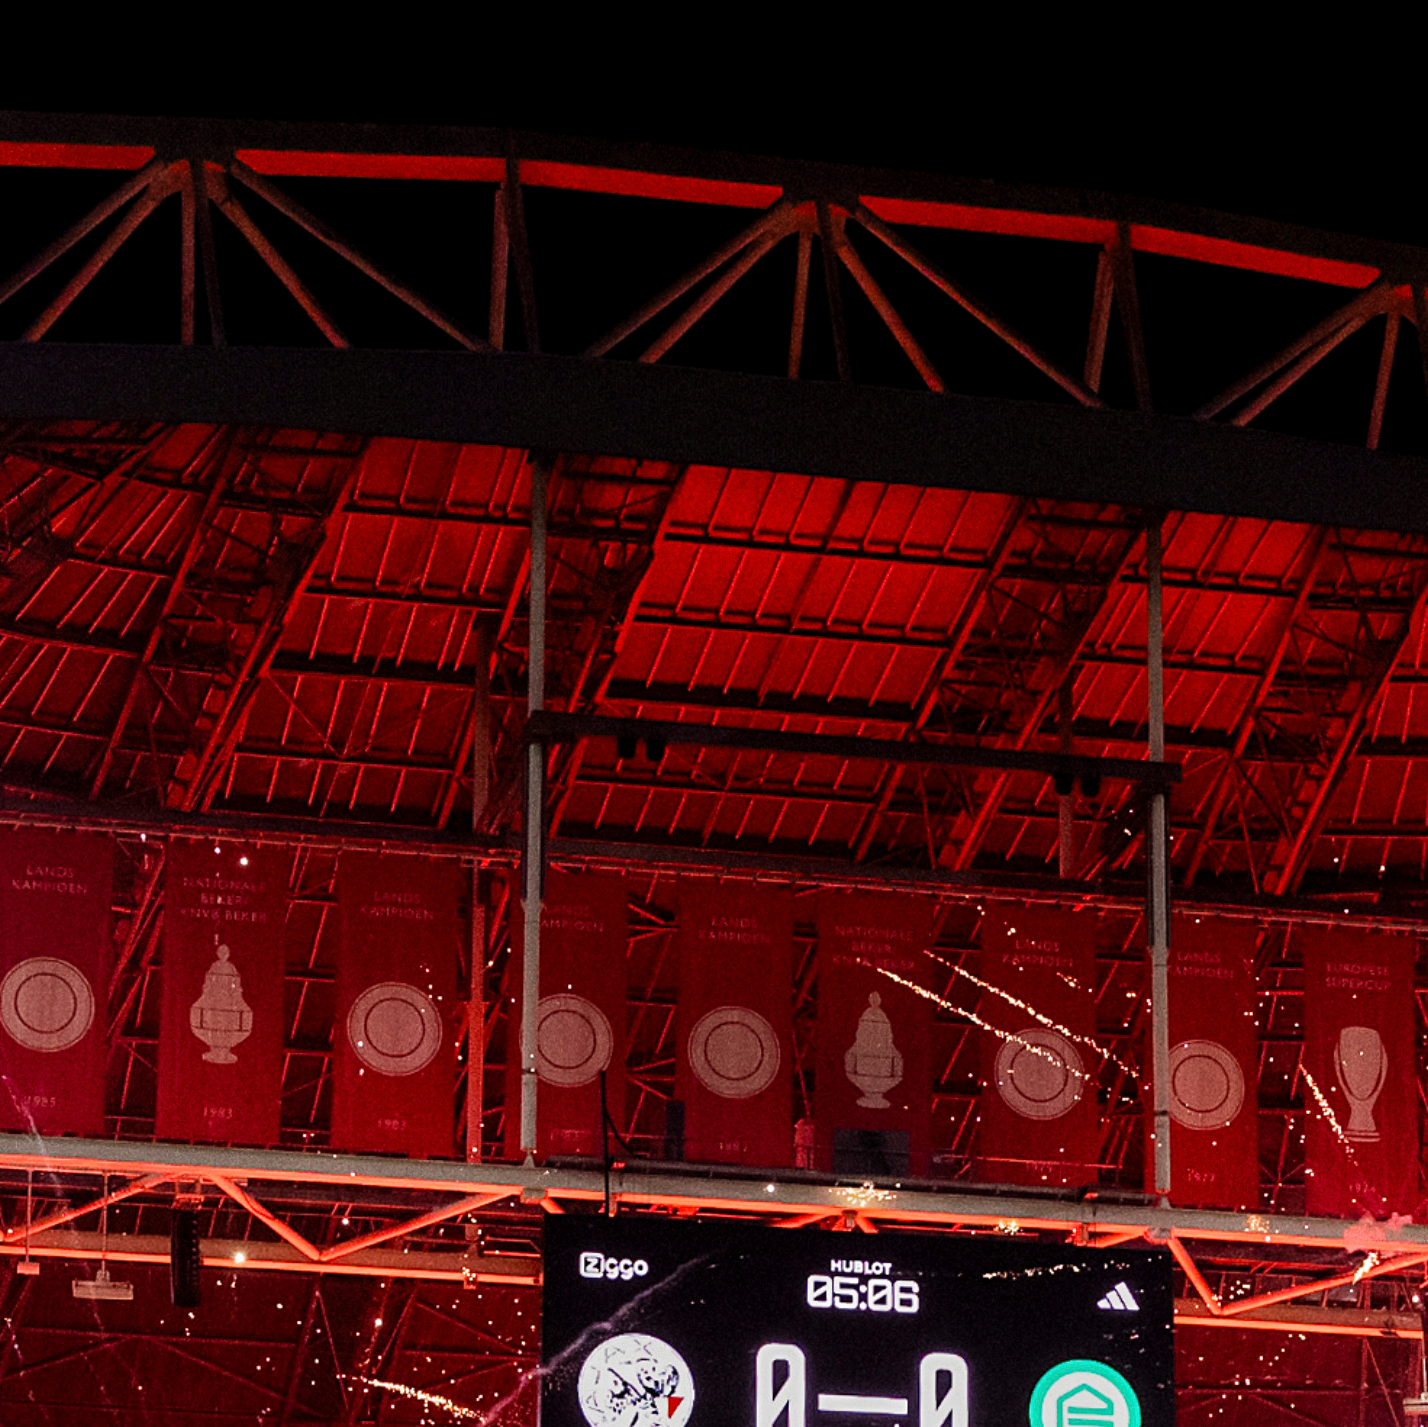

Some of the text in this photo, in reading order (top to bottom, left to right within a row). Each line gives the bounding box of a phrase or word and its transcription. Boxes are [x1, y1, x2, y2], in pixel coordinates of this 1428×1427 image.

[26, 864, 74, 878] LANDS
[11, 879, 88, 894] KAMPIOEN
[830, 1259, 892, 1275] HUBLOT
[806, 1275, 920, 1314] 05:06
